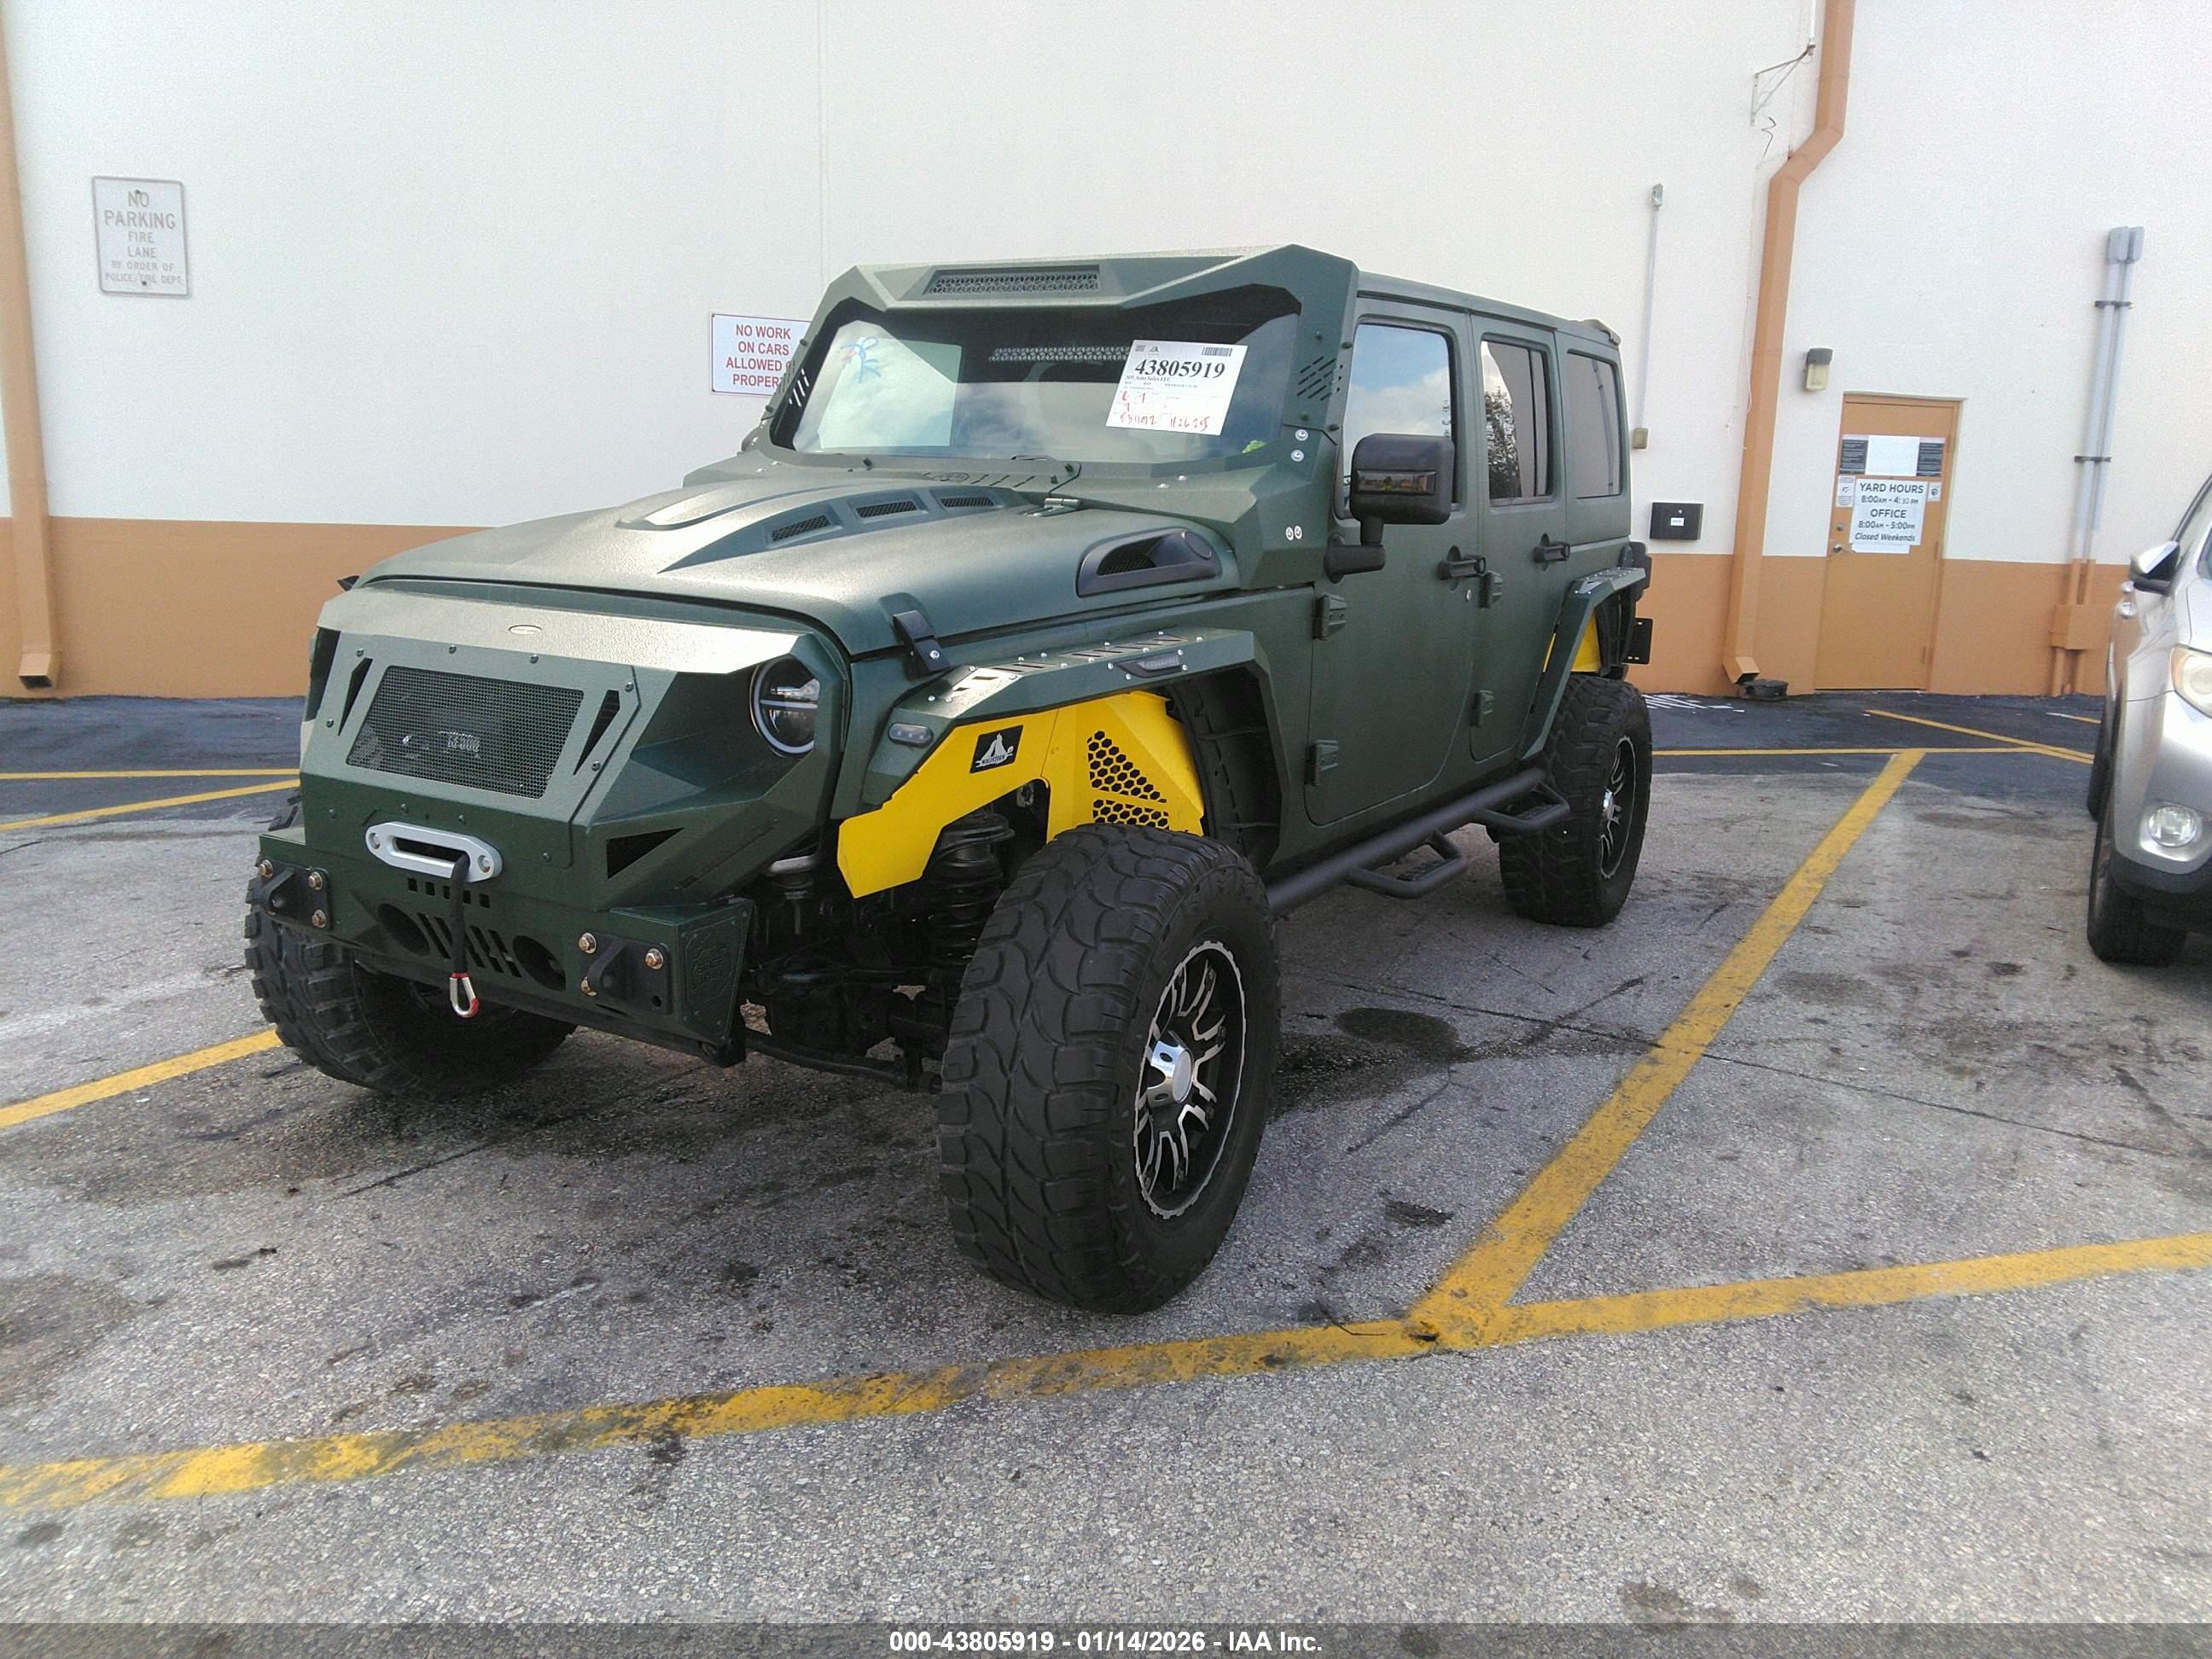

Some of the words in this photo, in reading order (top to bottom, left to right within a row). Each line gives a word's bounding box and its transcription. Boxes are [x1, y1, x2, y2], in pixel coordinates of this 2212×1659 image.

[127, 190, 149, 207] NO
[103, 210, 176, 230] PARKING
[128, 231, 155, 243] FIRE
[127, 246, 157, 258] LANE
[126, 261, 158, 271] ORDER
[162, 263, 174, 271] OF
[736, 324, 752, 336] NO
[755, 326, 791, 340] WORK
[738, 341, 754, 353] ON
[758, 342, 789, 356] CARS
[726, 357, 782, 371] ALLOWED
[1134, 358, 1225, 379] 43805919
[733, 374, 783, 387] PROPER
[1860, 483, 1887, 492] YARD
[1889, 484, 1924, 493] HOURS
[1870, 509, 1907, 518] OFFICE
